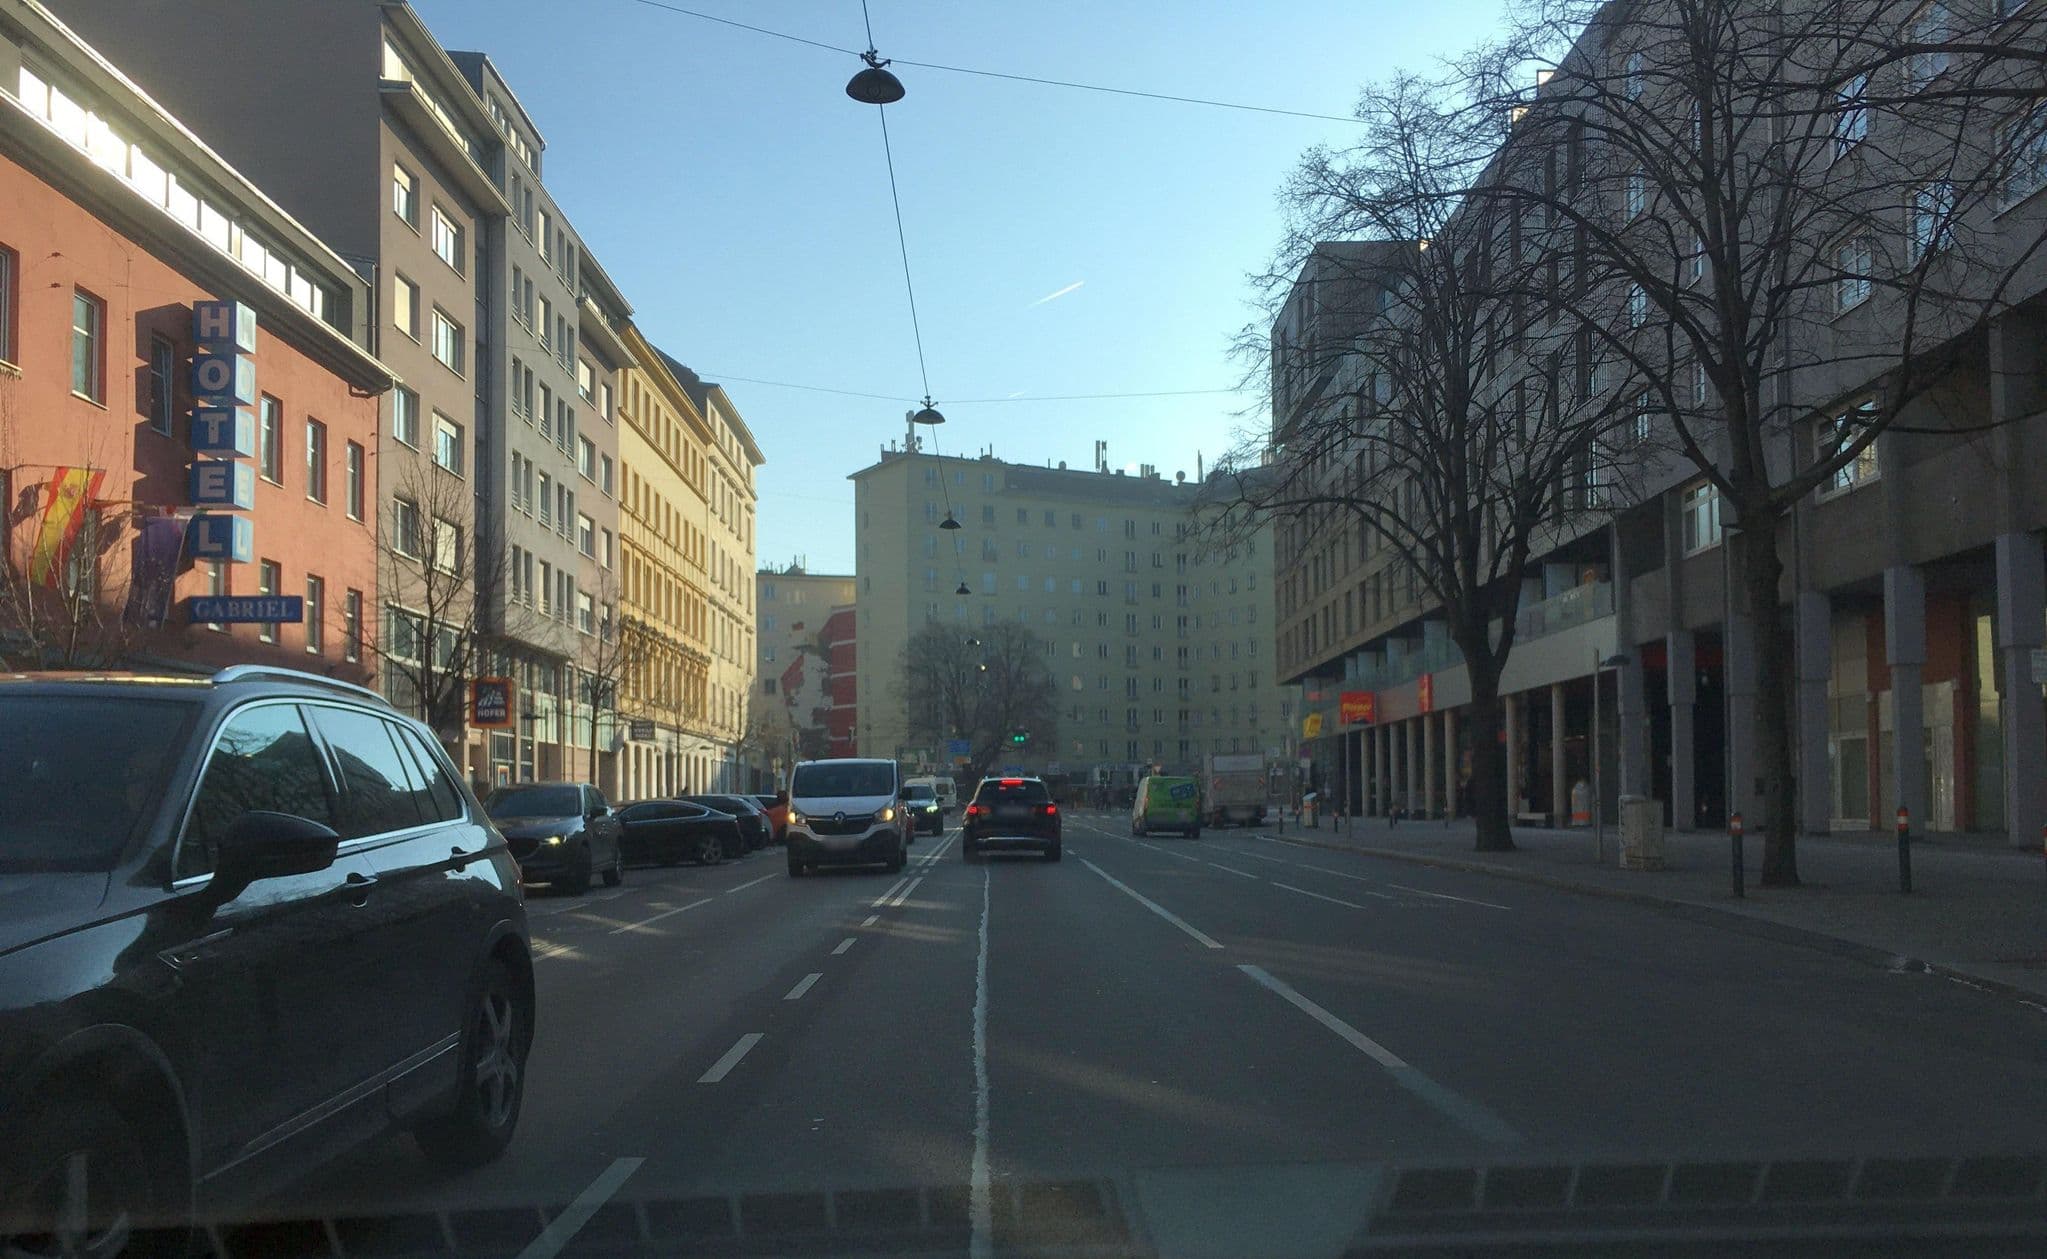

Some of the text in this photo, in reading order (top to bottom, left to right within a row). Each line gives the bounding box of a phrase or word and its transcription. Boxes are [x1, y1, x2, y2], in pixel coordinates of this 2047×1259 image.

[198, 306, 231, 552] HOTEL
[194, 600, 293, 618] GABRIEL
[477, 707, 506, 719] HOFER
